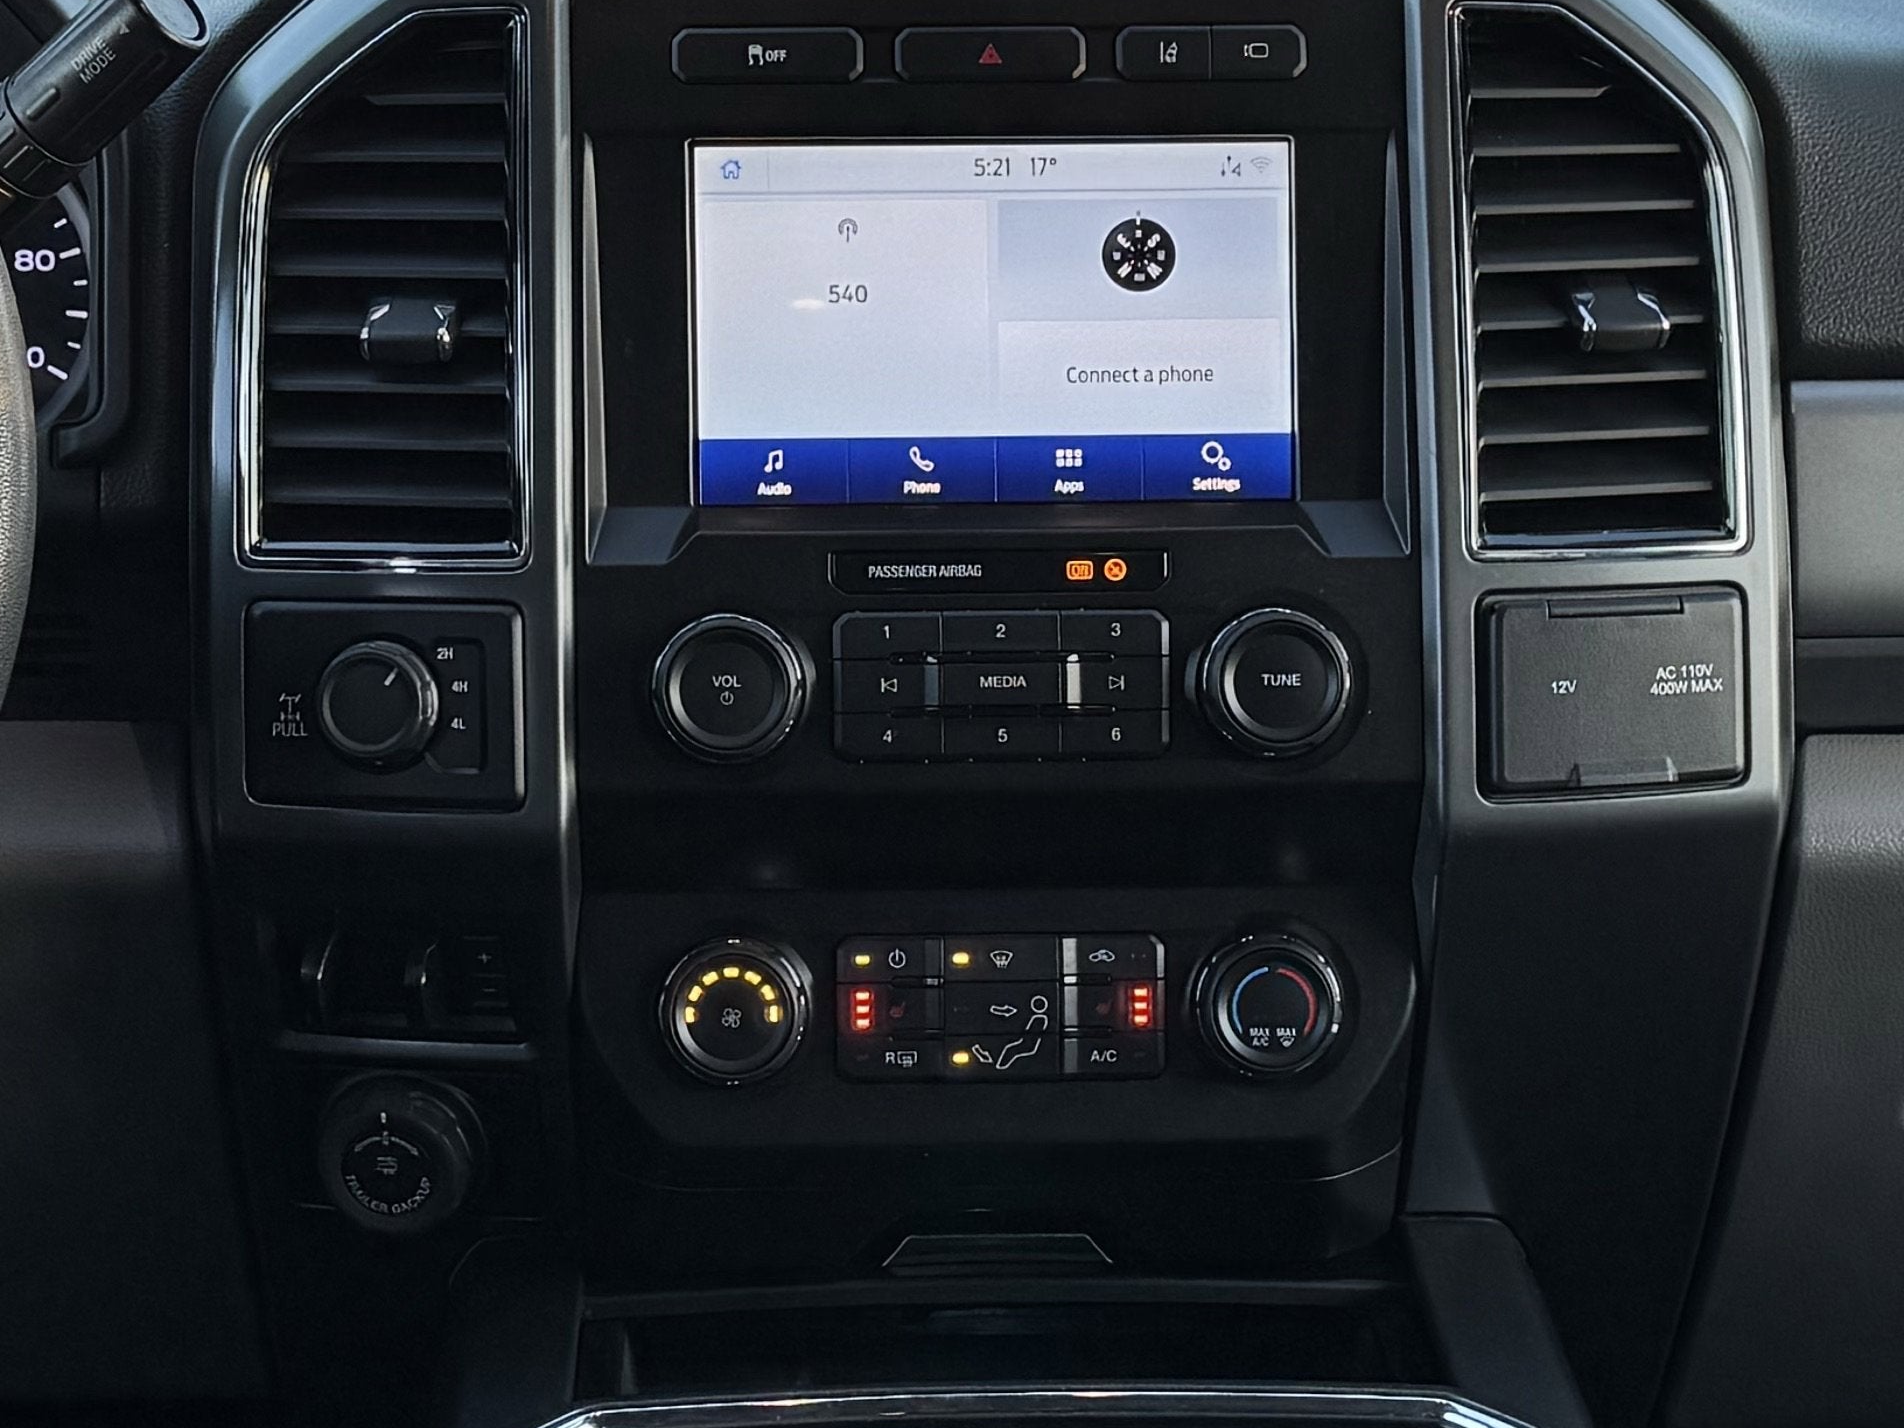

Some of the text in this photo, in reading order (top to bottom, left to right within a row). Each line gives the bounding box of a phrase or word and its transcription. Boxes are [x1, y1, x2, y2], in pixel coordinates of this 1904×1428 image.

[70, 35, 108, 73] DRIVE
[765, 49, 787, 62] OFF
[78, 46, 117, 85] MODE
[973, 156, 1010, 177] 5:21
[14, 248, 56, 272] 80
[828, 284, 868, 304] 540
[1066, 364, 1214, 386] Connect a phone
[757, 481, 792, 496] Audio
[903, 480, 941, 494] Phone
[1054, 478, 1085, 494] Apps
[1192, 476, 1241, 493] Settings
[868, 563, 937, 578] PASSENGER
[938, 563, 982, 577] AIRBAG
[883, 625, 891, 639] 1
[995, 623, 1006, 638] 2
[1110, 622, 1121, 637] 3
[436, 647, 454, 660] 2H
[1655, 663, 1714, 680] AC 110V
[451, 680, 468, 693] 4H
[712, 674, 742, 688] VOL
[979, 675, 1027, 688] MEDIA
[1261, 673, 1302, 687] TUNE
[1551, 679, 1577, 694] 12V
[1649, 678, 1724, 696] 400W MAX
[272, 722, 308, 737] PULL
[450, 717, 466, 730] 4L
[882, 729, 893, 743] 4
[997, 728, 1008, 743] 5
[1111, 727, 1121, 742] 6
[1090, 1049, 1117, 1062] A/C
[345, 1174, 431, 1214] TRAILER BACKUP
